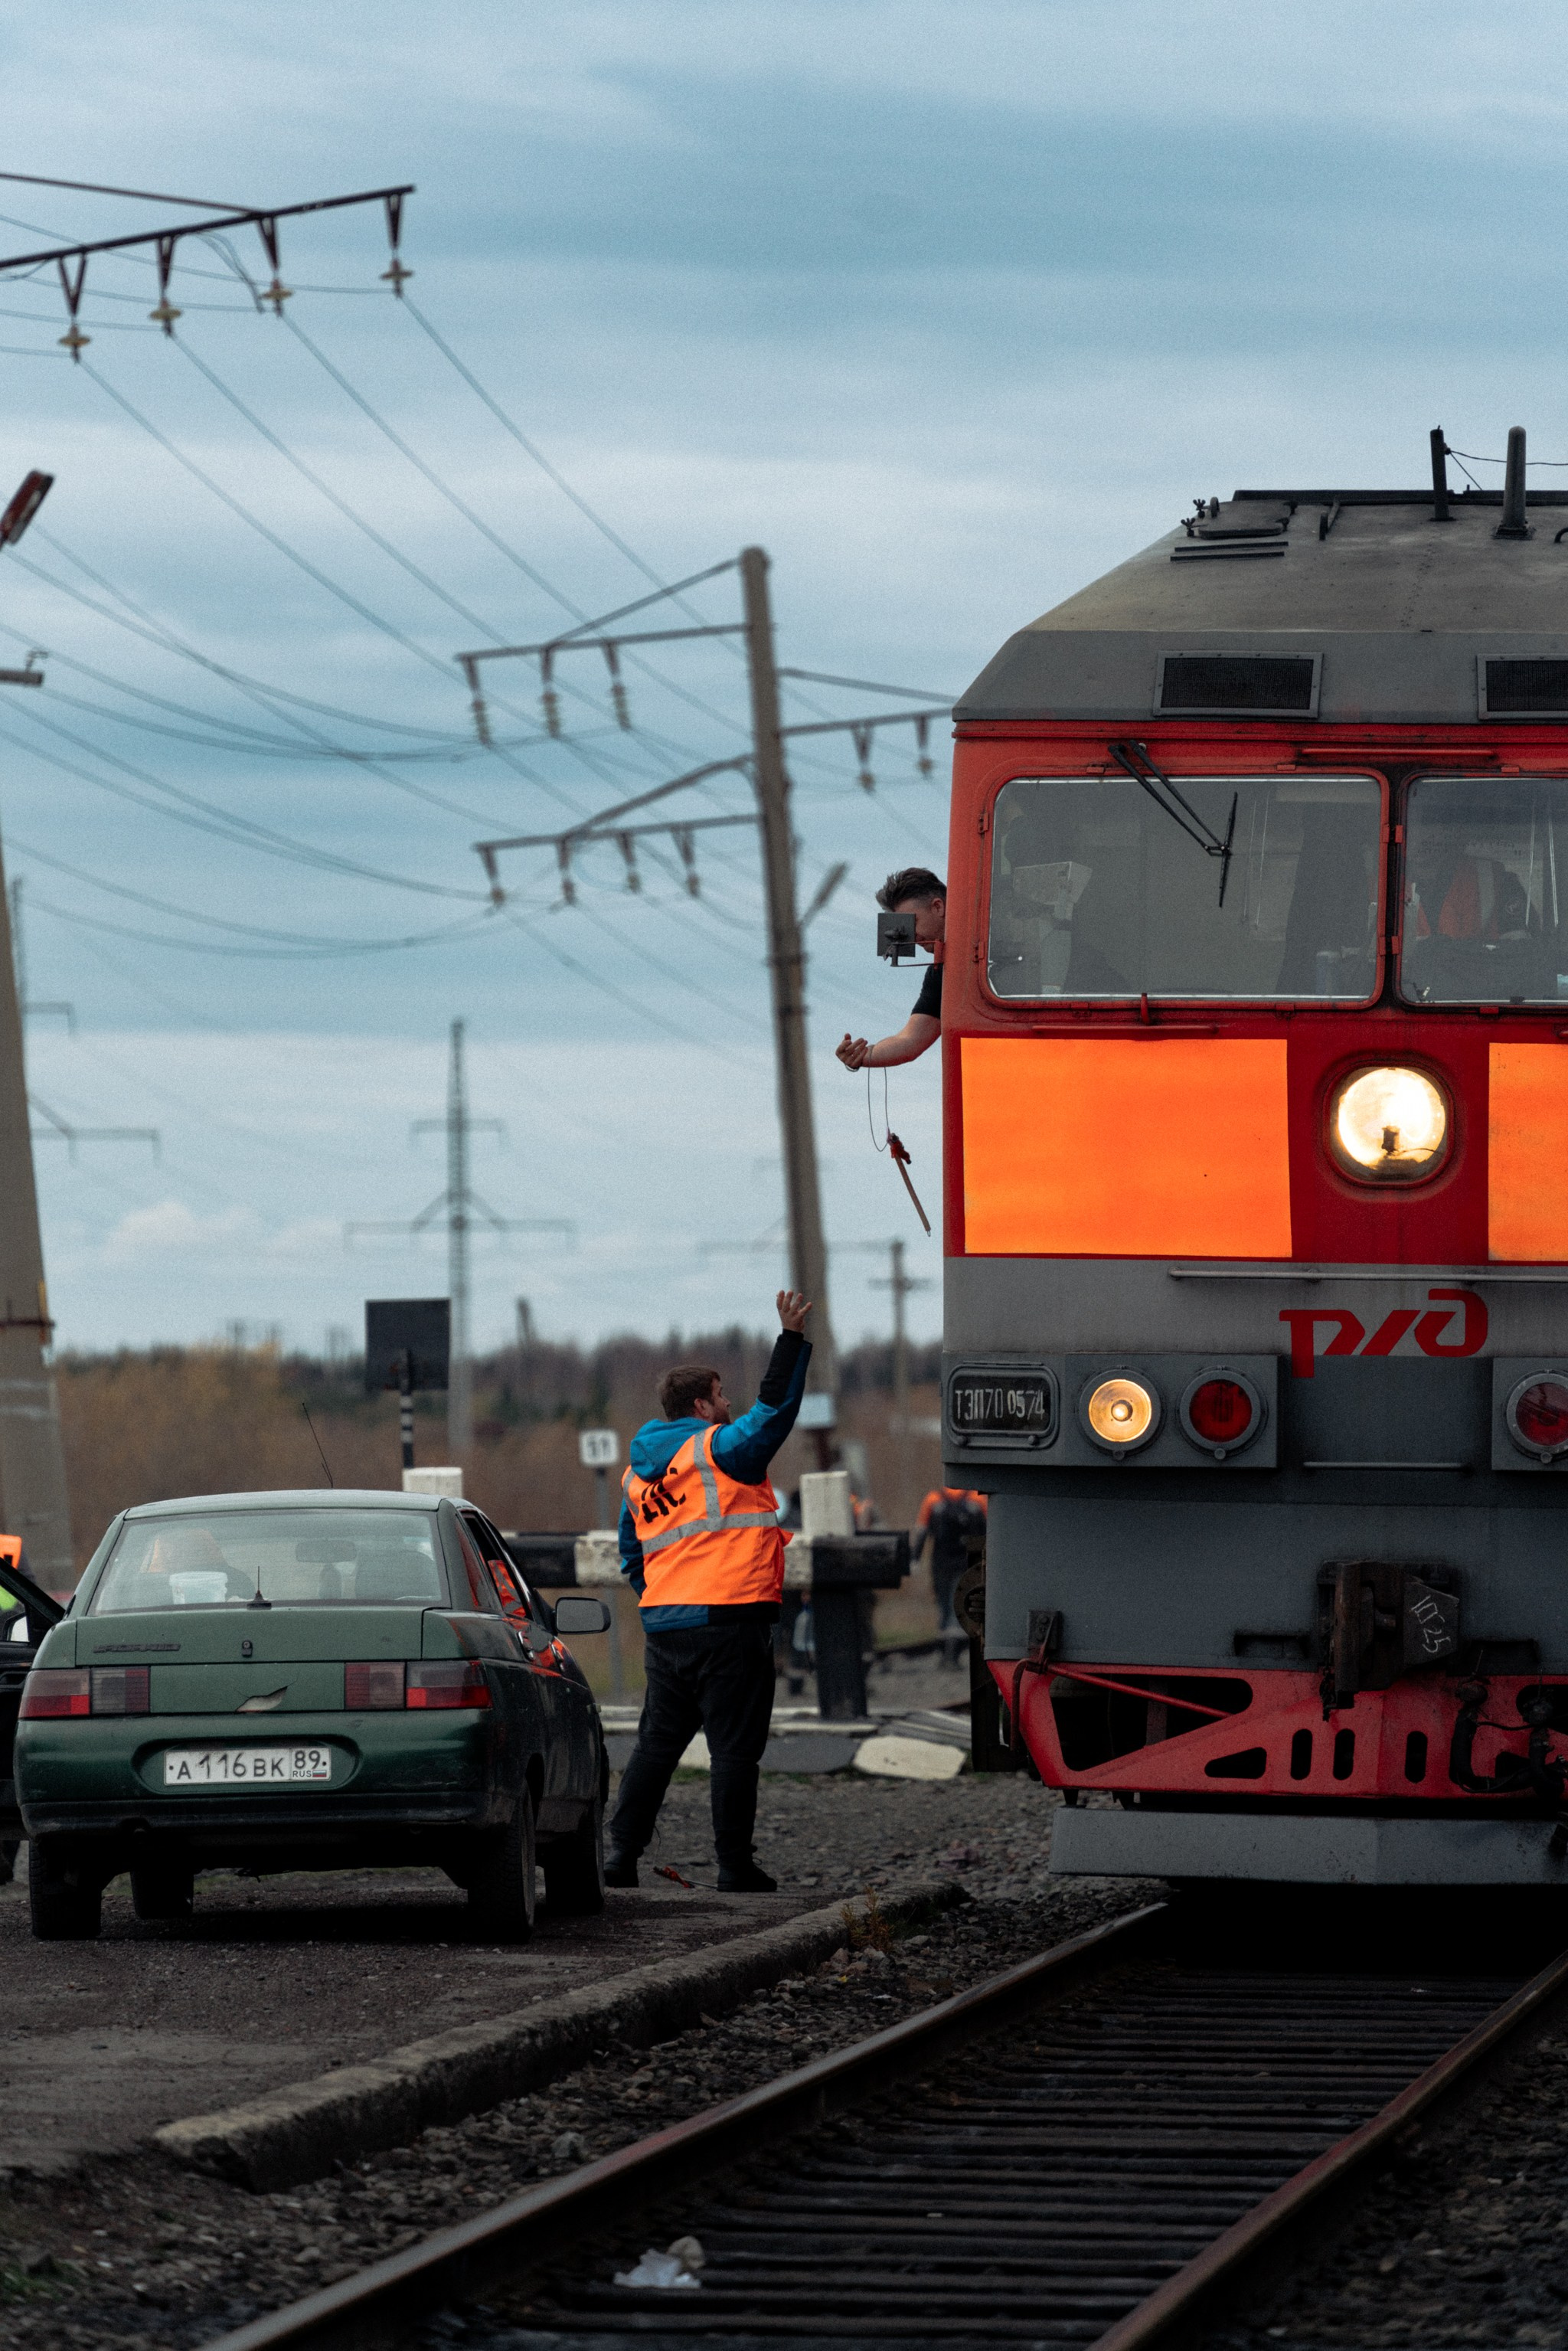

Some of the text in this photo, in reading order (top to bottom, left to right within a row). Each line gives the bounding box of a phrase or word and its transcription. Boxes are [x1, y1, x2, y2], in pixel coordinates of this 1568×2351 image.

[955, 1388, 1045, 1421] ТЭП70 0574
[294, 1750, 321, 1770] 89
[292, 1770, 312, 1778] RUS
